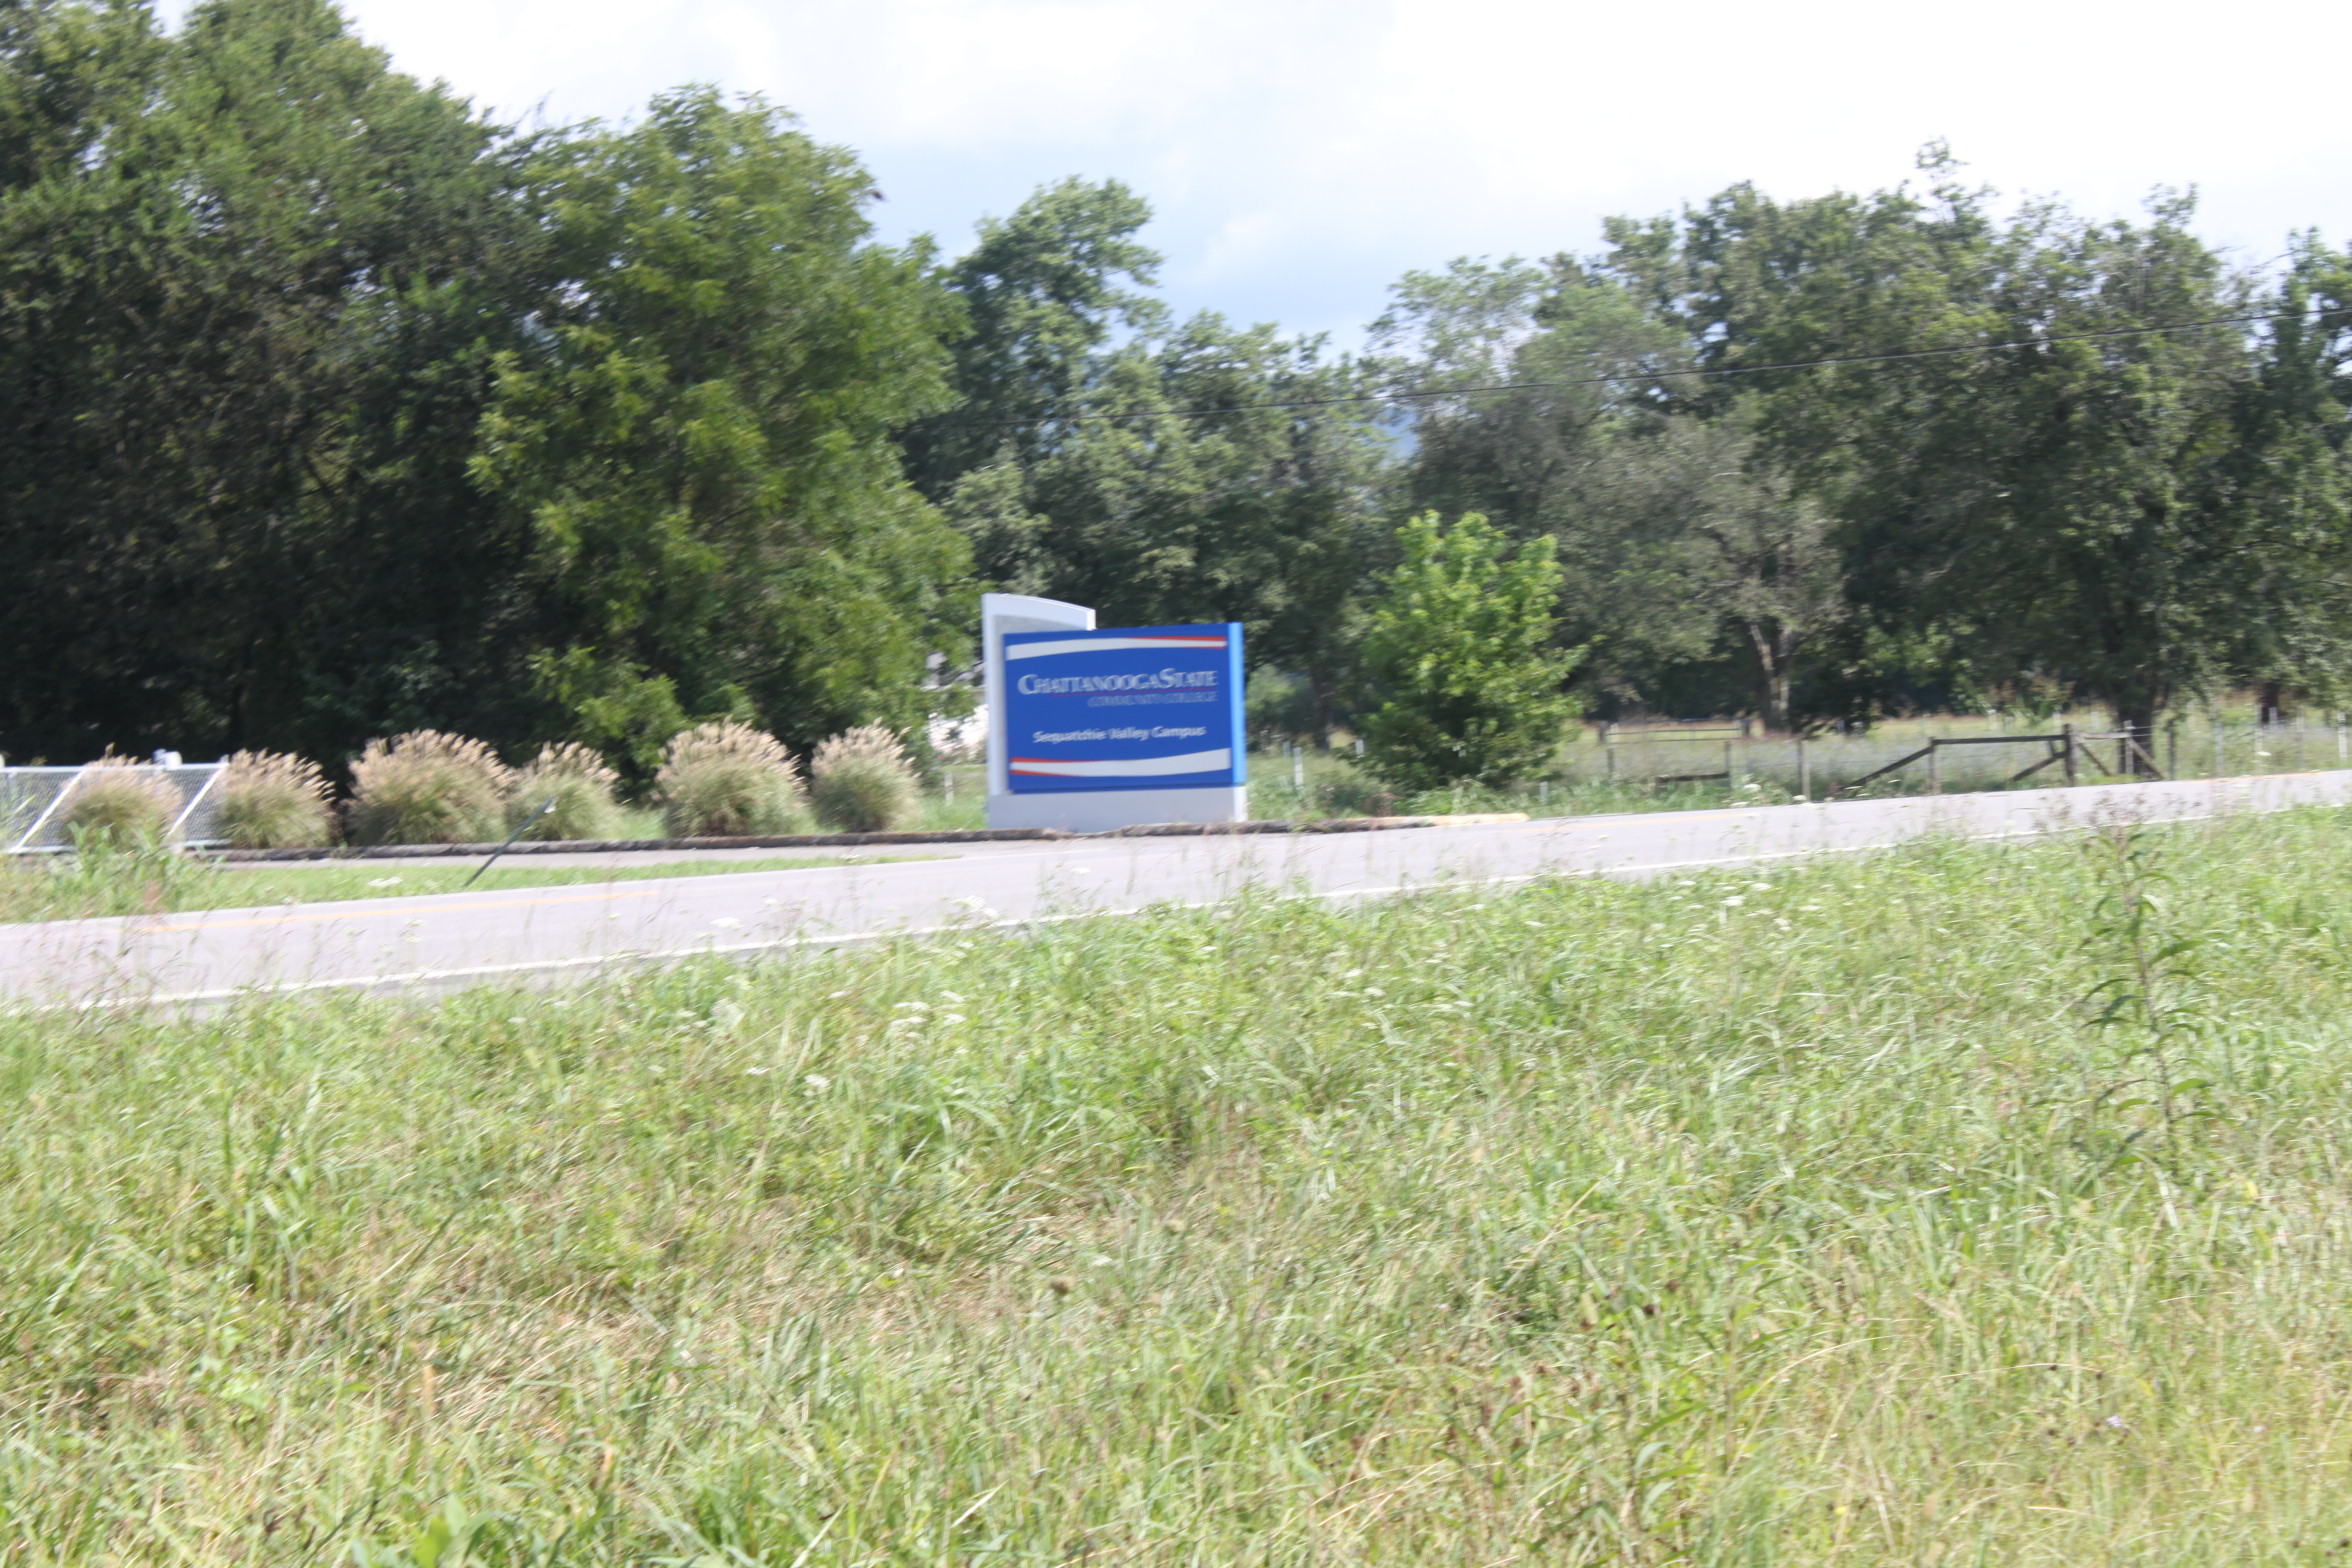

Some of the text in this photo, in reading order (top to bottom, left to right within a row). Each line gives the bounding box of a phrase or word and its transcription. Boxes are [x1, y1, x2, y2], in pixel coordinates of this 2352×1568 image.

[1033, 726, 1207, 744] Sequatchie Valley Campus
